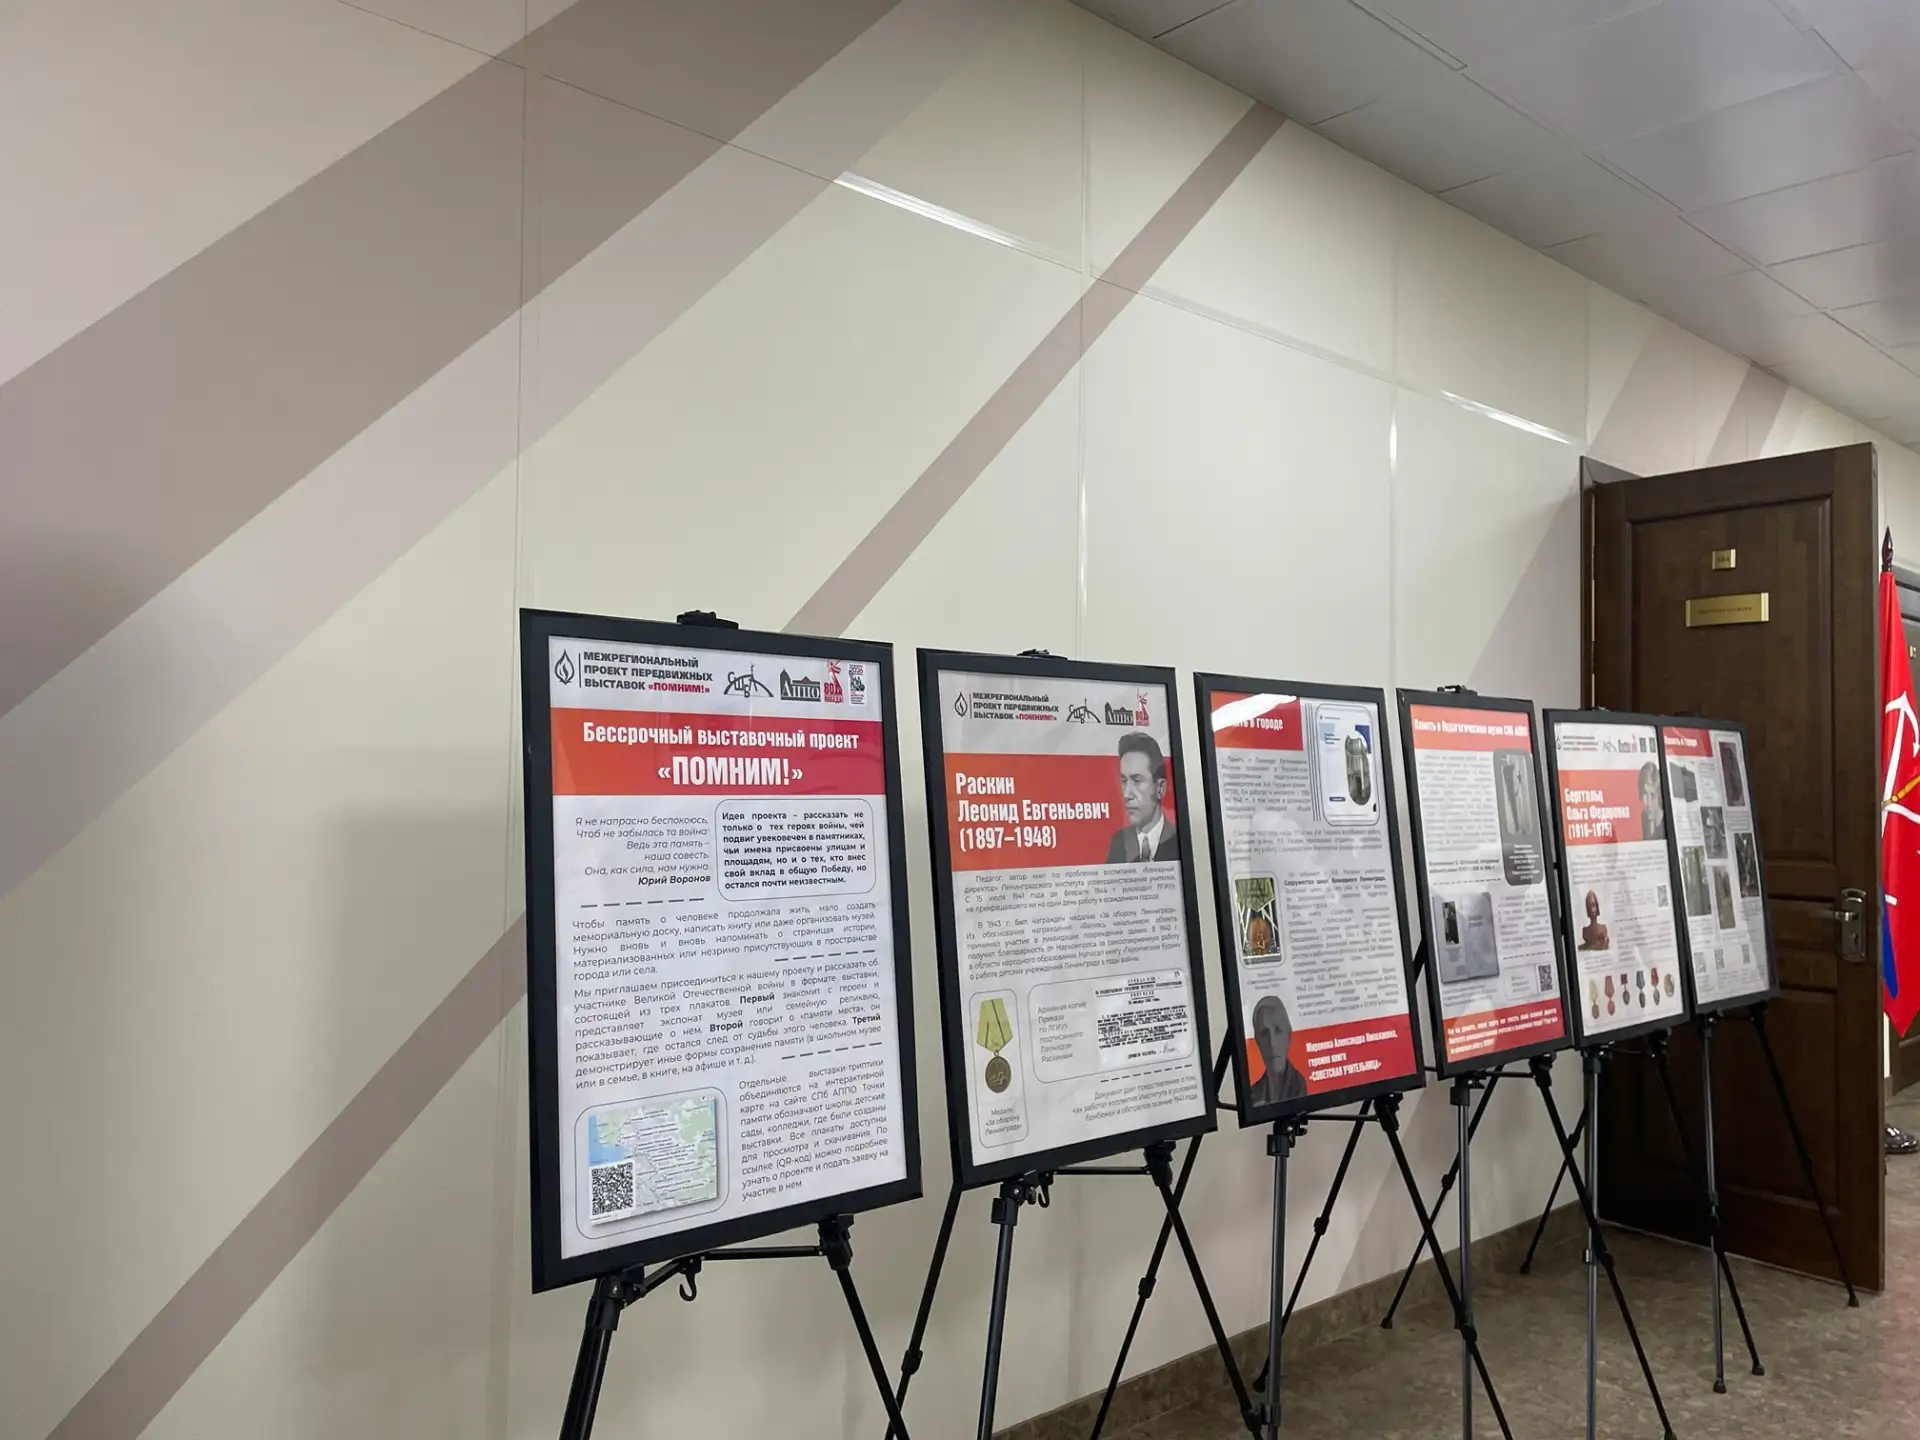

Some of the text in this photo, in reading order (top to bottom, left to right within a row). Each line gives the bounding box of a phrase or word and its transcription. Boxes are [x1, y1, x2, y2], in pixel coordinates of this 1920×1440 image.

[583, 651, 699, 668] МЕЖРЕГИОНАЛЬНЫЙ
[583, 664, 713, 682] ПРОЕКТ ПЕРЕДВИЖНЫХ
[584, 677, 710, 694] ВЫСТАВОК «ПОМНИМ!»
[1256, 718, 1284, 730] городе
[583, 721, 859, 750] Бессрочный выставочный проект
[658, 755, 803, 785] «ПОМНИМ!»
[955, 772, 1014, 795] Раскин
[721, 811, 745, 821] Идея
[751, 812, 787, 822] проекта
[803, 811, 849, 821] рассказать
[957, 799, 1110, 824] Леонид Евгеньевич
[575, 817, 583, 826] Я
[599, 818, 649, 827] напрасно
[722, 824, 754, 832] только
[786, 823, 816, 832] героях
[818, 821, 847, 830] войны,
[849, 820, 865, 829] чей
[576, 828, 601, 838] Чтоб
[617, 827, 664, 837] забылась
[722, 832, 865, 844] подвиг увековечен памятниках,
[959, 825, 1057, 852] (1897–1948)
[626, 840, 703, 850] Ведь эта память
[775, 844, 823, 854] присвоены
[825, 843, 856, 853] улицам
[644, 852, 671, 861] наша
[723, 858, 773, 866] площадям,
[809, 855, 826, 863] тех,
[584, 866, 608, 876] Она,
[657, 864, 677, 872] нам
[723, 868, 746, 878] свой
[749, 868, 776, 877] вклад
[787, 865, 818, 876] общую
[820, 864, 854, 874] Победу,
[638, 875, 710, 886] Юрий Воронов
[724, 876, 846, 890] остался почти неизвестным.
[572, 902, 876, 932] Чтобы память человеке продолжала мало создать
[572, 927, 651, 944] мемориальную
[683, 924, 726, 934] написать
[727, 921, 753, 931] книгу
[754, 920, 771, 929] или
[772, 918, 795, 928] даже
[795, 914, 850, 927] организовать
[573, 927, 834, 957] Нужно вновь вновь напоминать страницах
[573, 934, 877, 968] материализованных или незримо присутствующих пространстве
[573, 968, 610, 982] города
[611, 967, 632, 977] или
[573, 983, 752, 1014] участнике Великой Отечественной
[739, 991, 775, 1005] Первый
[709, 1019, 744, 1033] Второй
[851, 1012, 881, 1026] Третий
[574, 1014, 702, 1040] представляет экспонат
[574, 1058, 655, 1078] демонстрирует
[738, 1075, 787, 1090] Отдельные
[810, 1084, 858, 1101] СПб АППО
